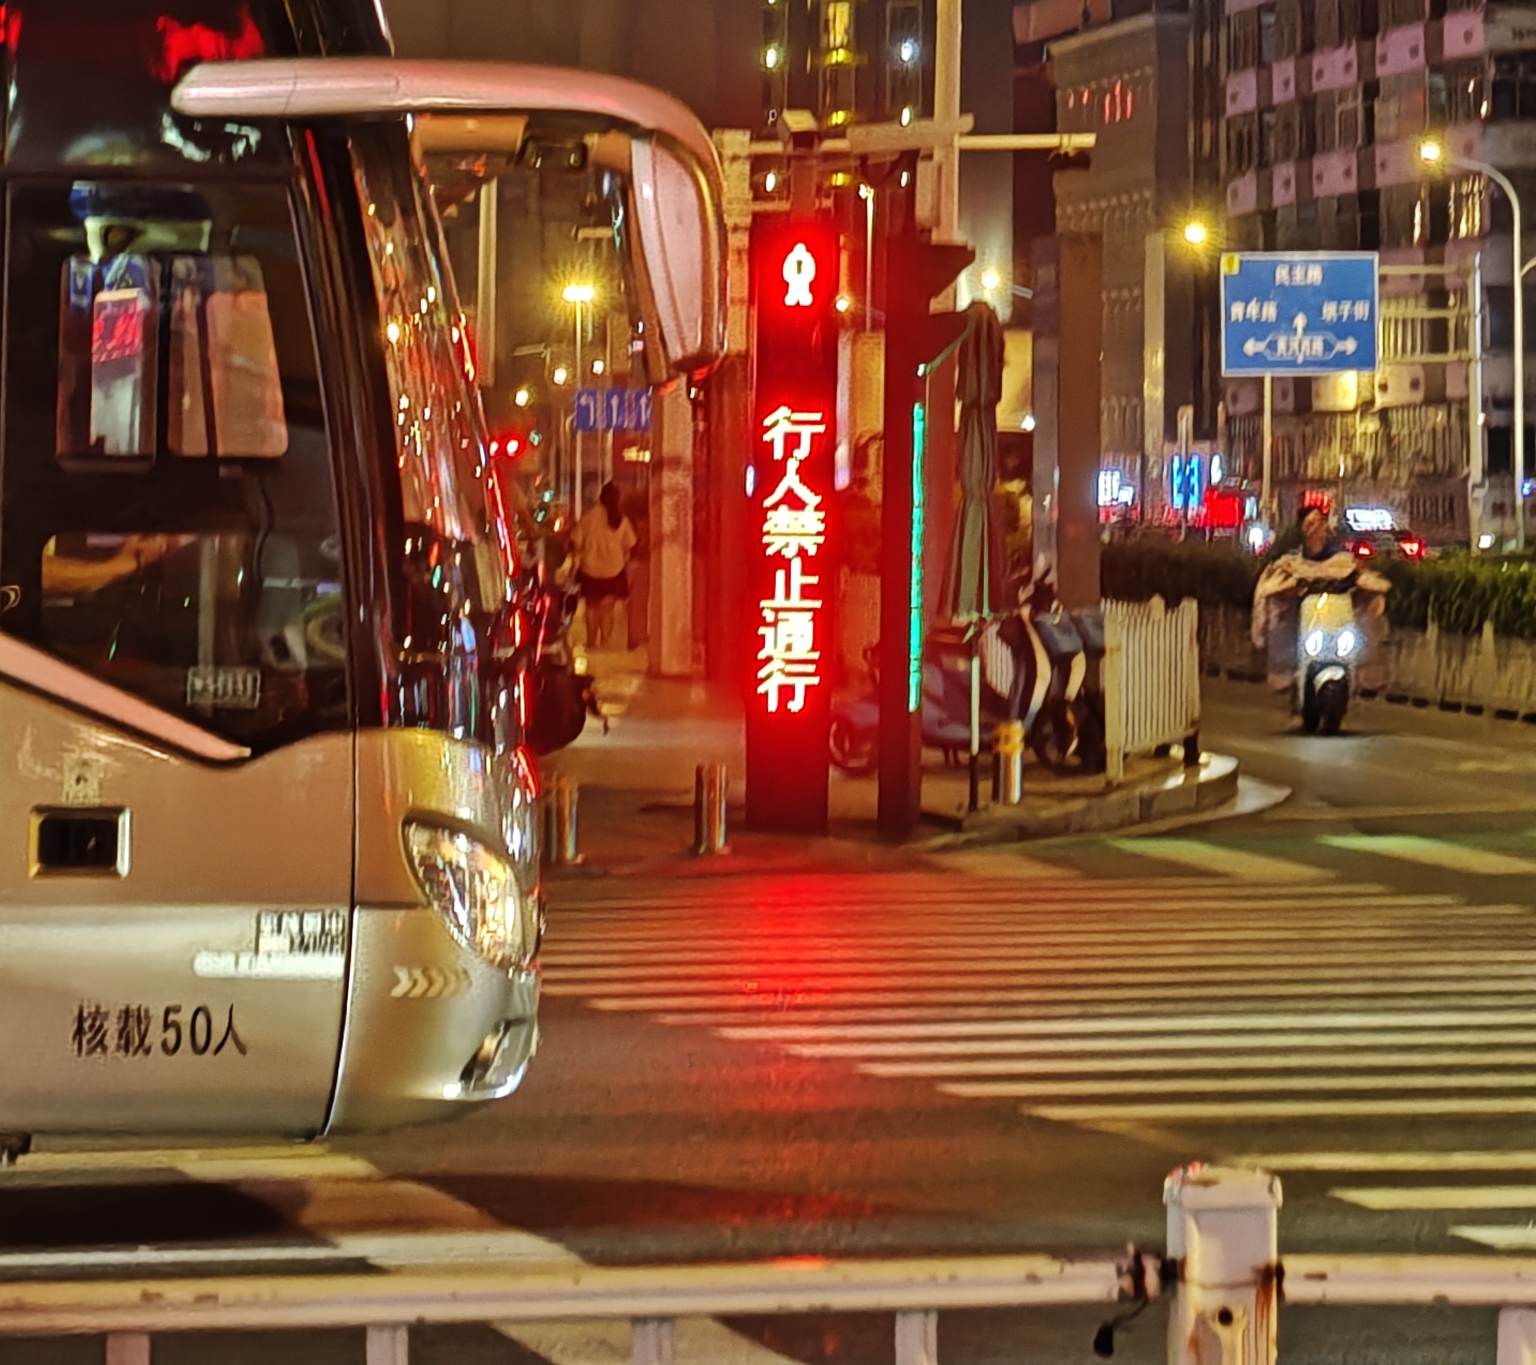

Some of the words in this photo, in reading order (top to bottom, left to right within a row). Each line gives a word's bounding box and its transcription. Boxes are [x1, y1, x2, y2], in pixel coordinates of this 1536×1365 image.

[756, 405, 826, 714] 行人禁止通行
[71, 1002, 248, 1058] 核载50人
